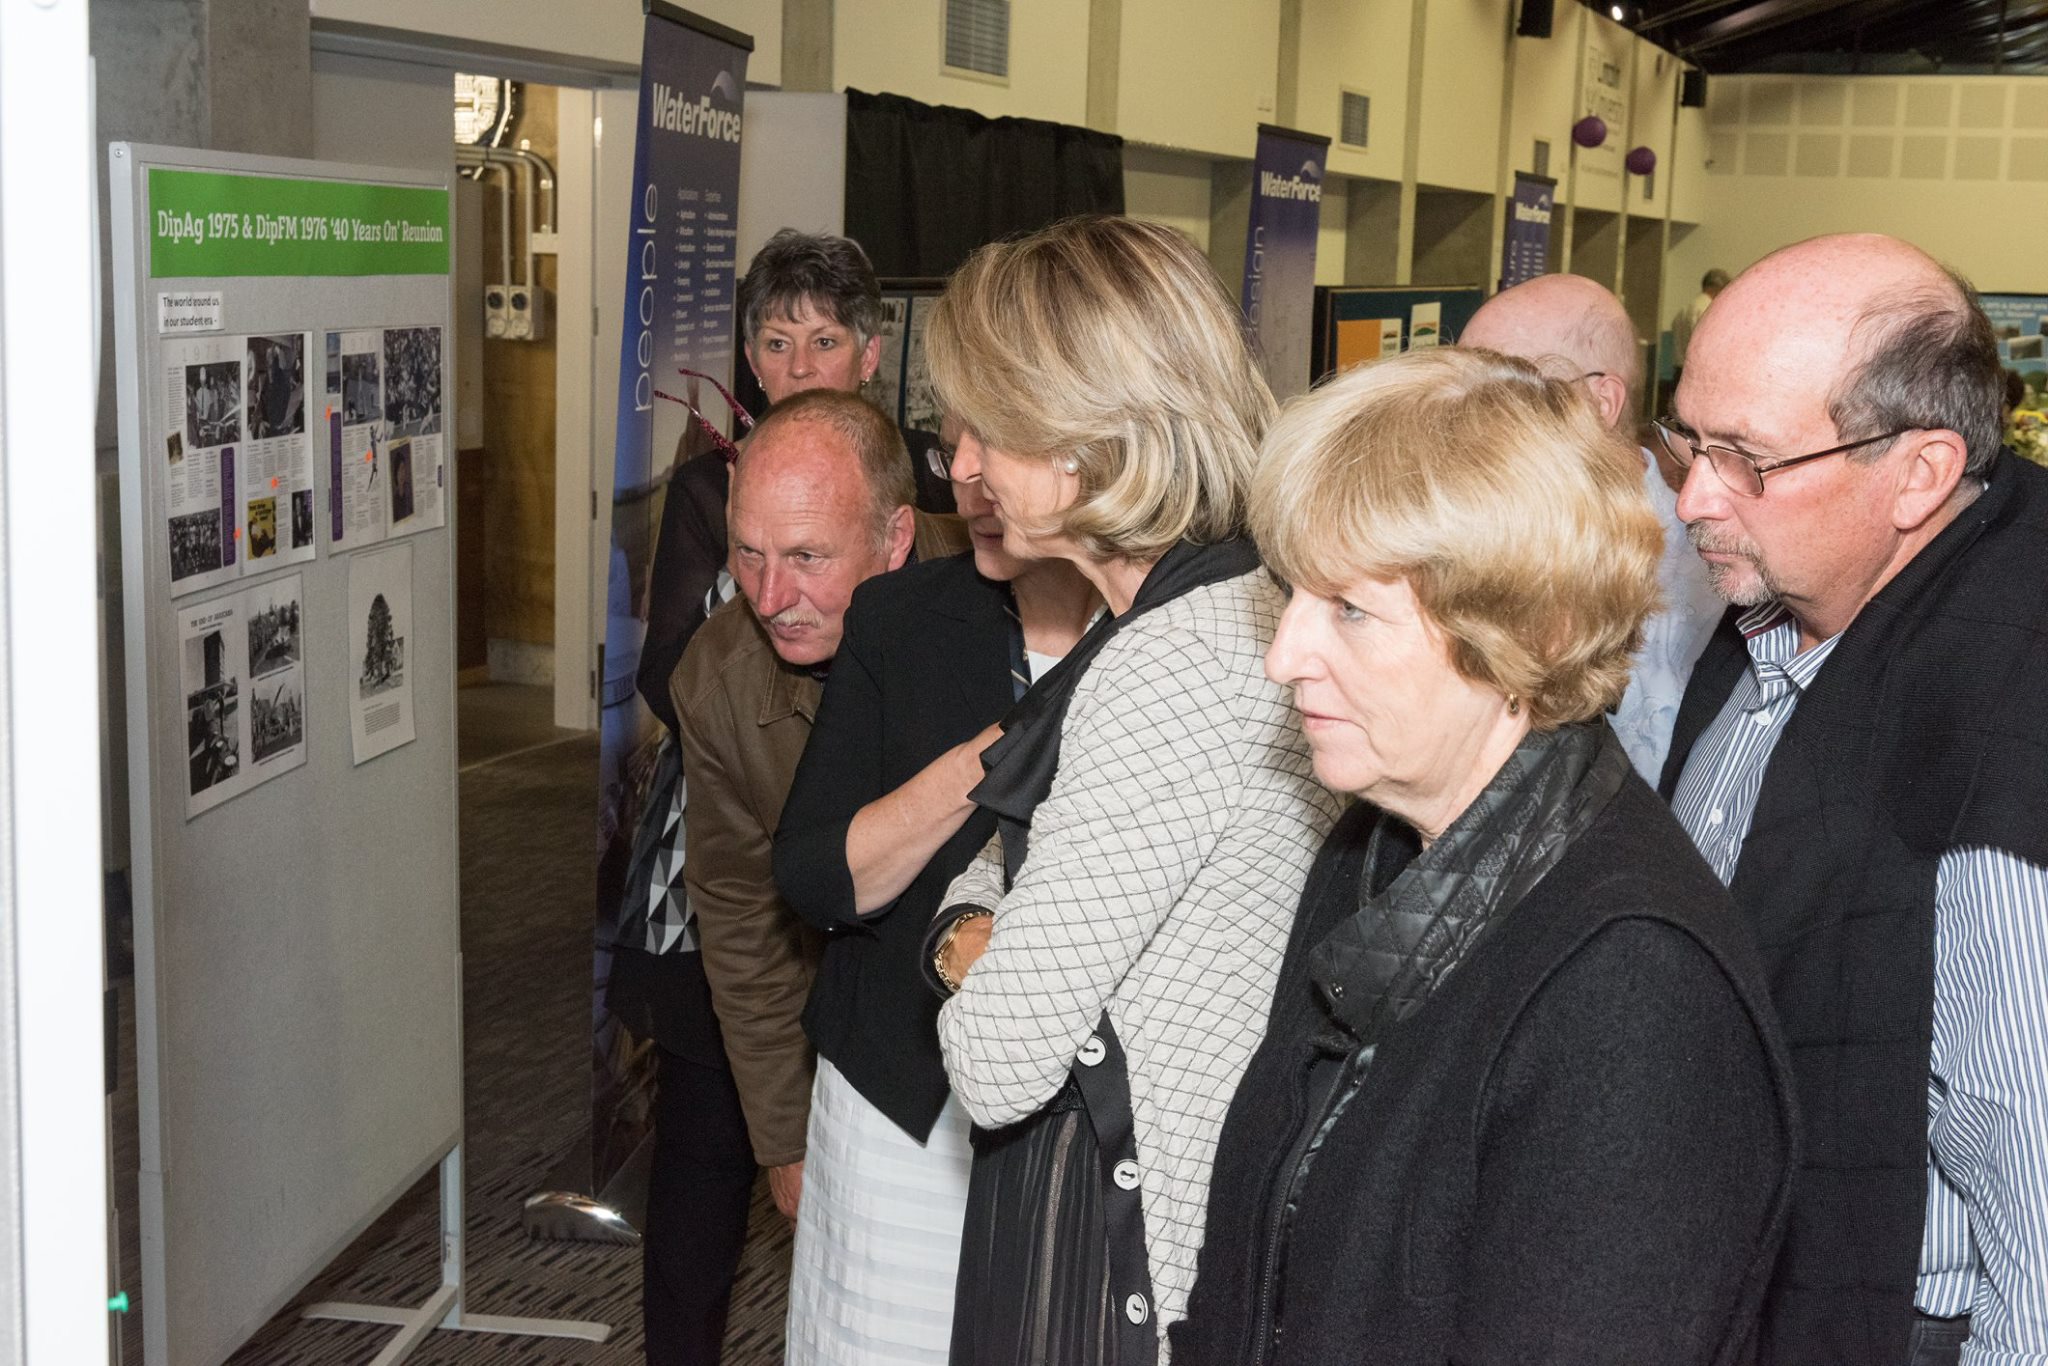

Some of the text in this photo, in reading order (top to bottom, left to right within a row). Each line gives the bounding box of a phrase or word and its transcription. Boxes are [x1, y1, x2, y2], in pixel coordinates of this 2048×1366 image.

[653, 83, 741, 143] WaterForce
[1260, 170, 1321, 202] WaterForce
[158, 209, 204, 244] DipAg
[208, 213, 239, 239] 1975
[242, 214, 253, 239] &
[256, 214, 298, 245] DipFM
[301, 217, 327, 241] 1976
[352, 219, 381, 241] Years
[402, 220, 443, 242] Reunion
[163, 297, 173, 307] The
[174, 296, 192, 307] world
[636, 184, 657, 411] people
[170, 318, 179, 327] our
[180, 315, 203, 327] student
